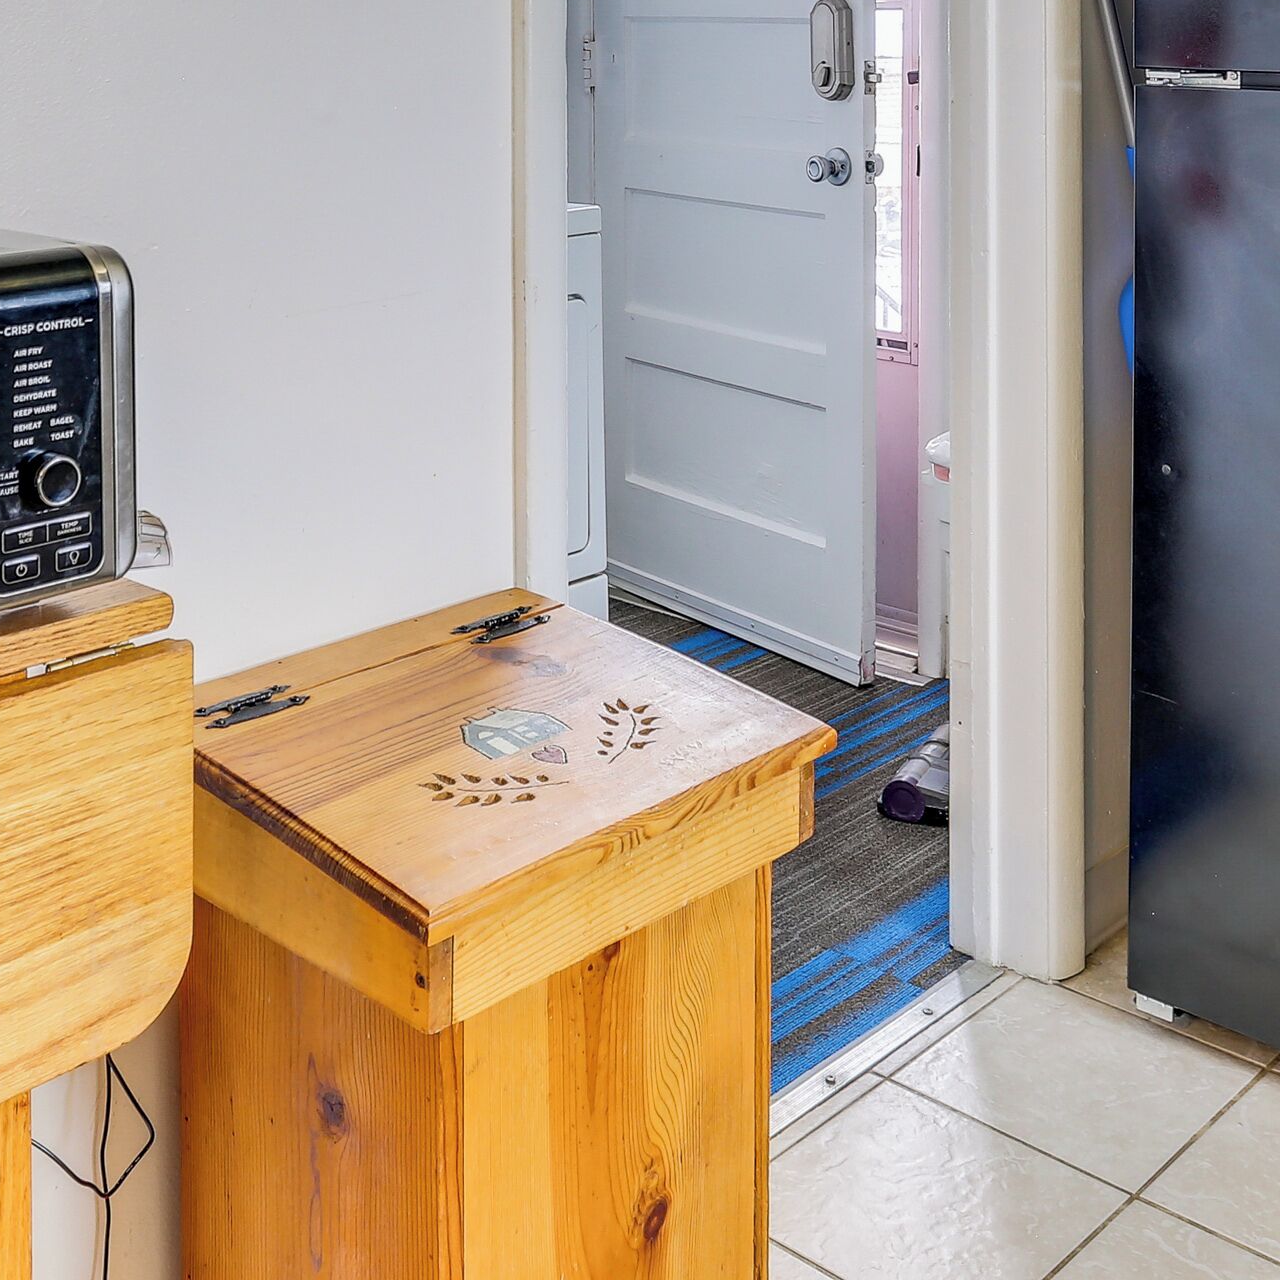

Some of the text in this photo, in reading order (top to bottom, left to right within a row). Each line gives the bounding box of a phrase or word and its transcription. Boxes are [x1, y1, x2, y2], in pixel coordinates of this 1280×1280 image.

[4, 316, 85, 337] CRISP CONTROL
[13, 346, 44, 358] AIR FRY
[13, 360, 53, 373] AIR ROAST
[13, 375, 51, 388] AIR BROIL
[13, 389, 57, 403] DEHYDRATE
[13, 404, 57, 418] KEEP WARM
[13, 416, 75, 433] REHEAT BAGEL
[13, 430, 75, 448] BAKE TOAST
[61, 521, 79, 530] TEMP
[18, 530, 34, 539] TIME
